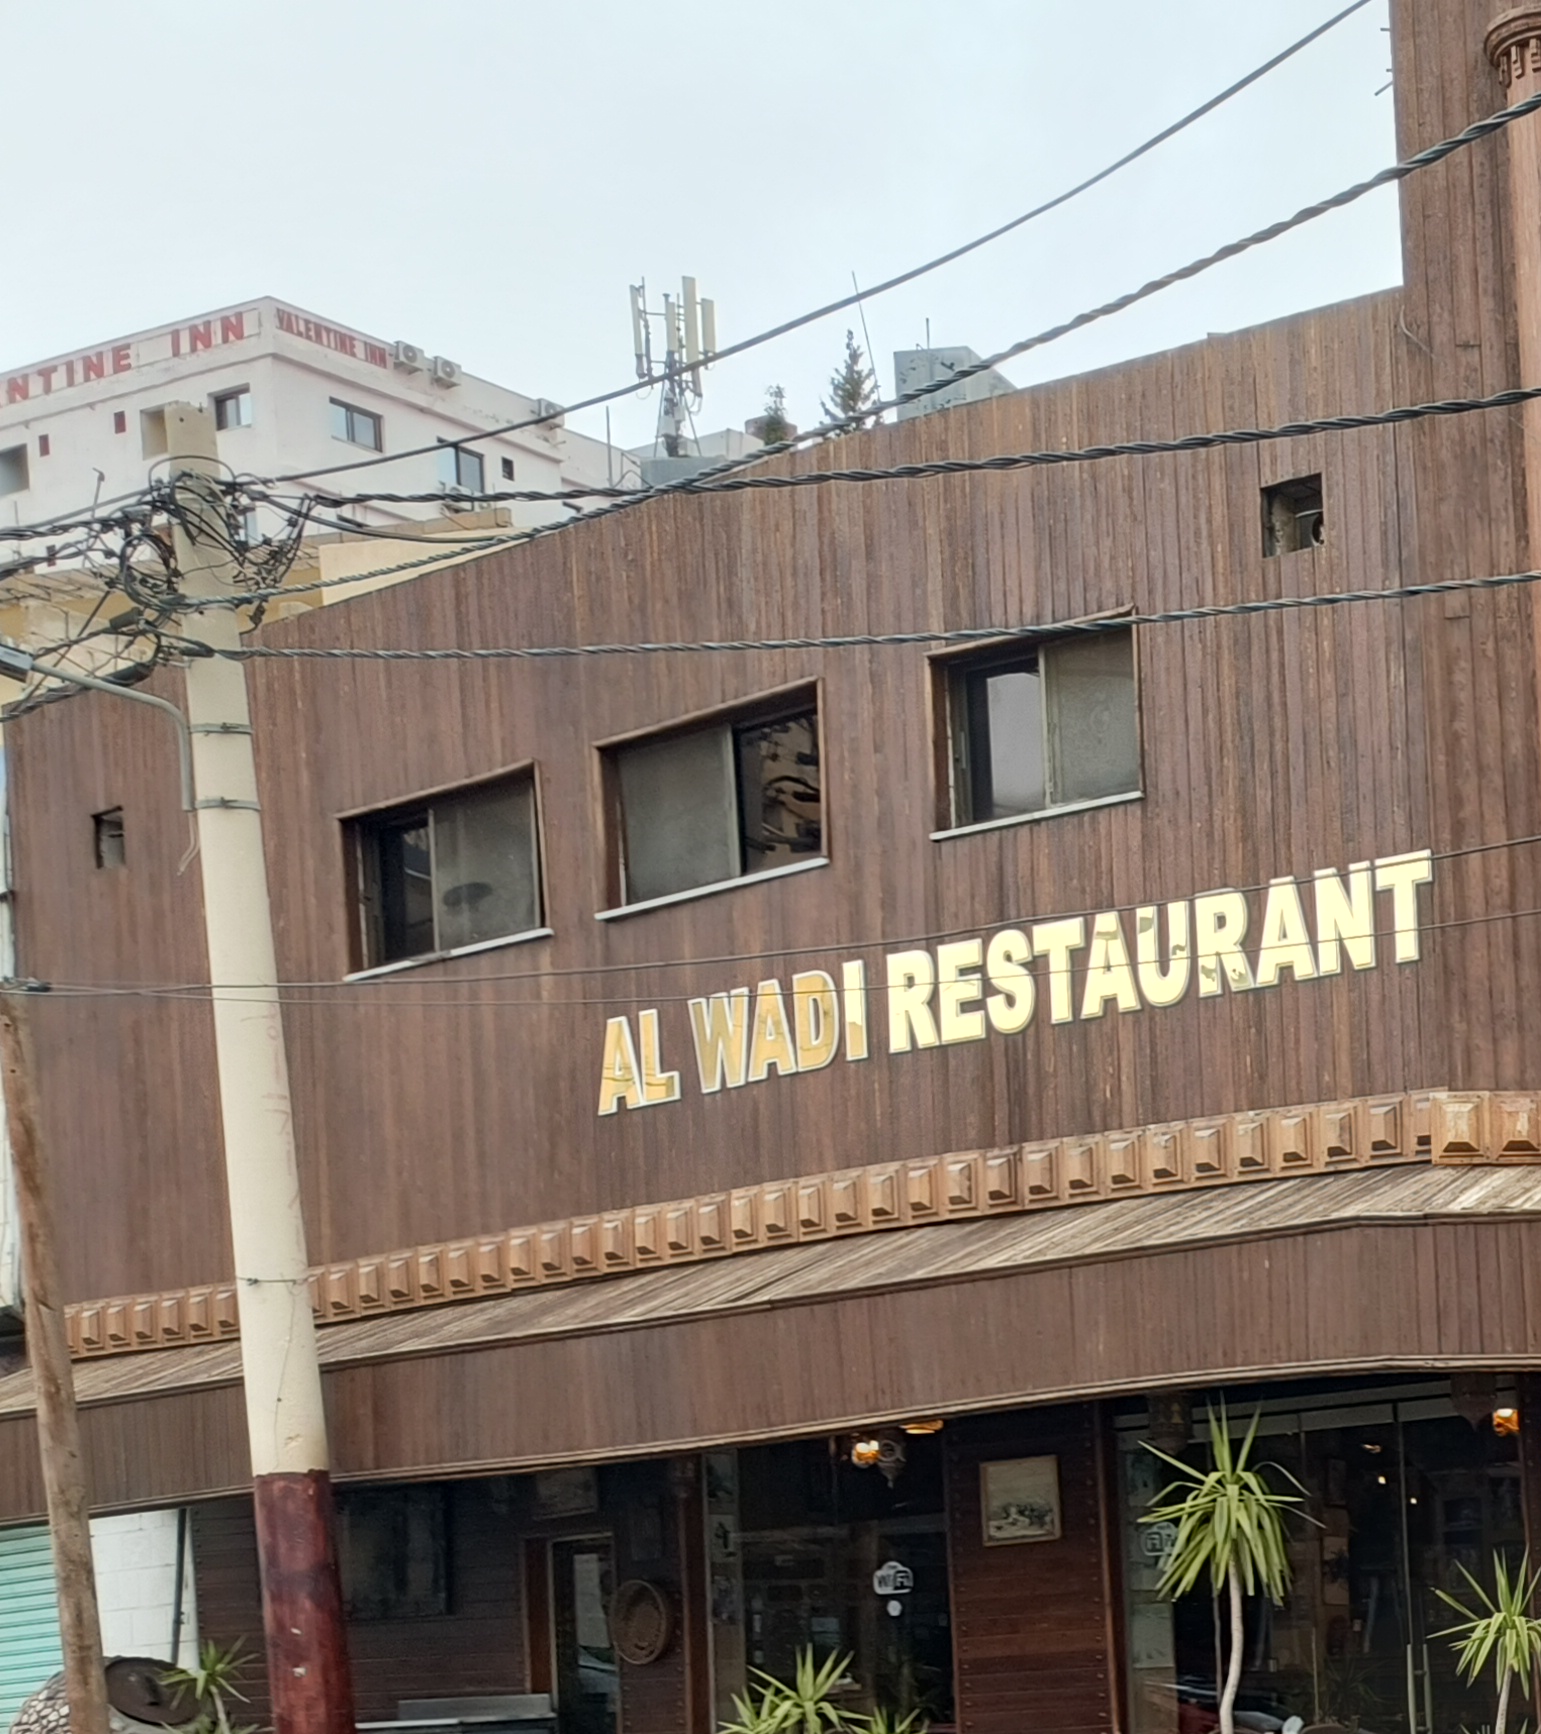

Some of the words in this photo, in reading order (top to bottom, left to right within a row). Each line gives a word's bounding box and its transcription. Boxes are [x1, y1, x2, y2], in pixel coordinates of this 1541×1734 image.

[2, 342, 132, 404] NTINE
[170, 311, 246, 358] INN
[276, 307, 357, 357] VALENTINE
[364, 340, 387, 370] INN
[597, 1008, 681, 1116] AL
[687, 959, 869, 1094] WADI
[886, 848, 1434, 1055] RESTAURANT
